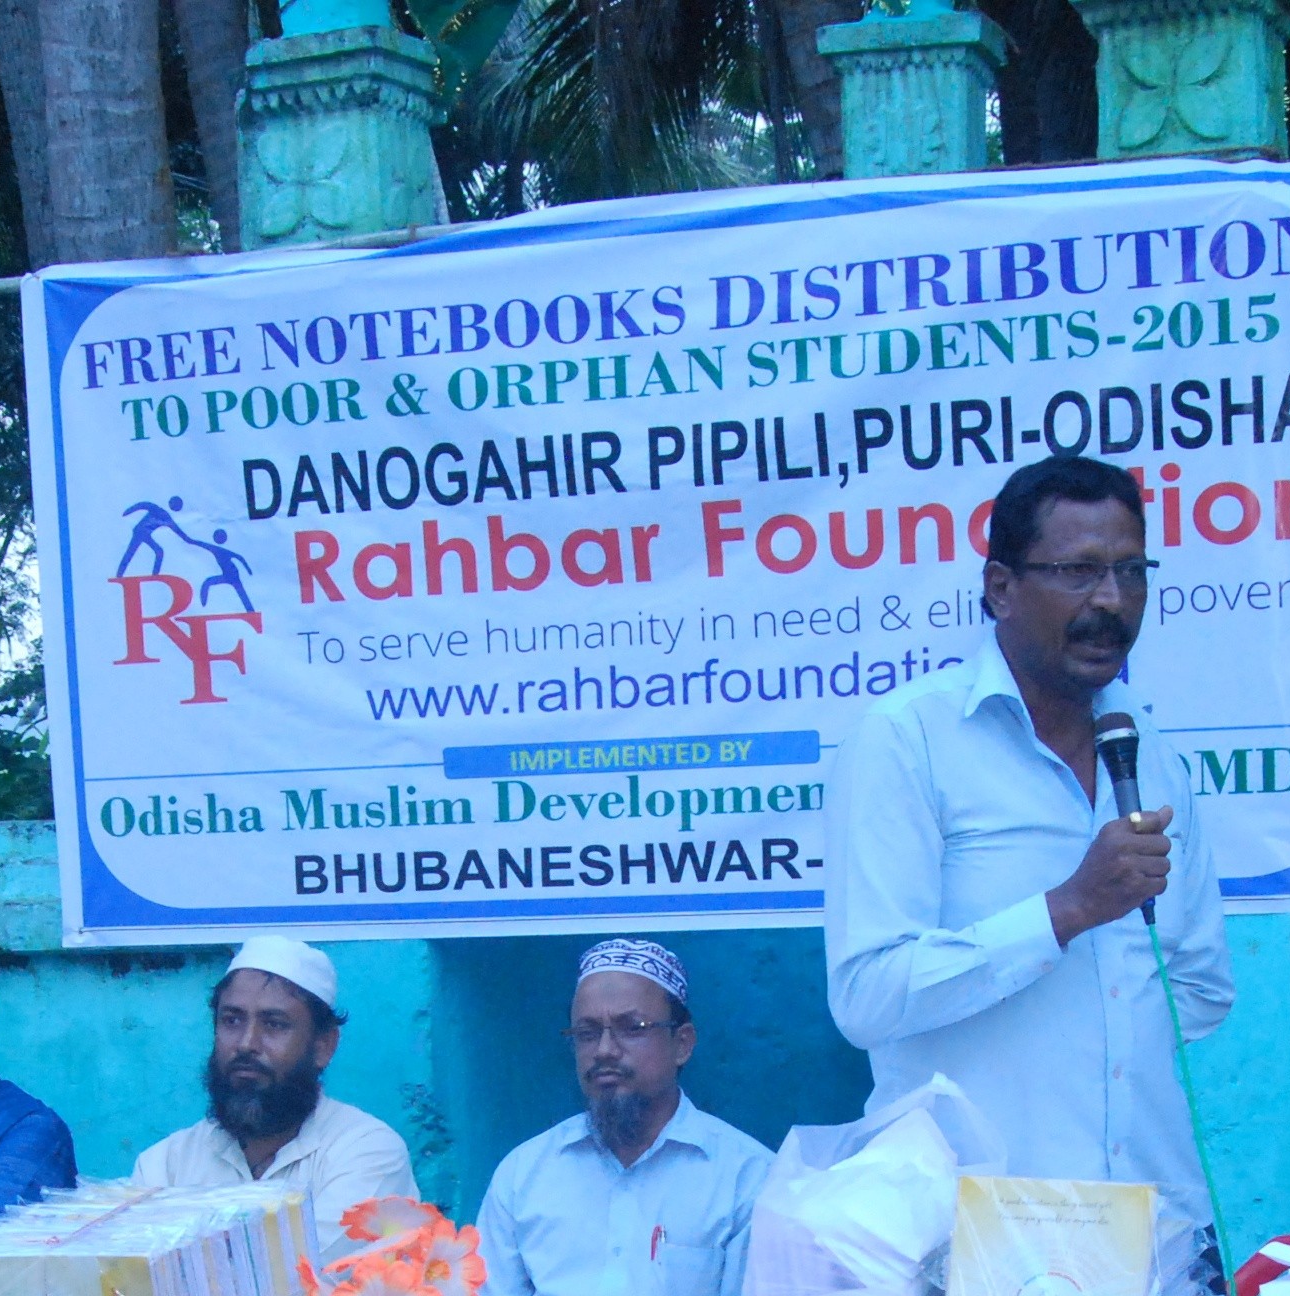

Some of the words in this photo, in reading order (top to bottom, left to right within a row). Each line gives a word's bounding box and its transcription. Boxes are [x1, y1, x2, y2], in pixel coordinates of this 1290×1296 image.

[82, 327, 241, 389] FREE
[260, 286, 685, 373] NOTEBOOKS
[122, 395, 189, 441] TO
[206, 377, 367, 433] POOR
[386, 373, 429, 418] &
[448, 342, 724, 411] ORPHAN
[748, 293, 1280, 387] STUDENTS-2015
[243, 431, 627, 520] DANOGAHIR
[294, 514, 660, 604] Rahbar
[297, 630, 345, 665] To
[358, 629, 469, 662] serve
[485, 608, 686, 655] humanity
[700, 607, 734, 641] in
[754, 596, 861, 638] need
[879, 595, 913, 631] &
[509, 740, 710, 772] IMPLEMENTED
[719, 739, 752, 763] BY
[100, 793, 265, 838] Odisha
[281, 785, 473, 832] Muslim
[492, 775, 825, 832] Developmen
